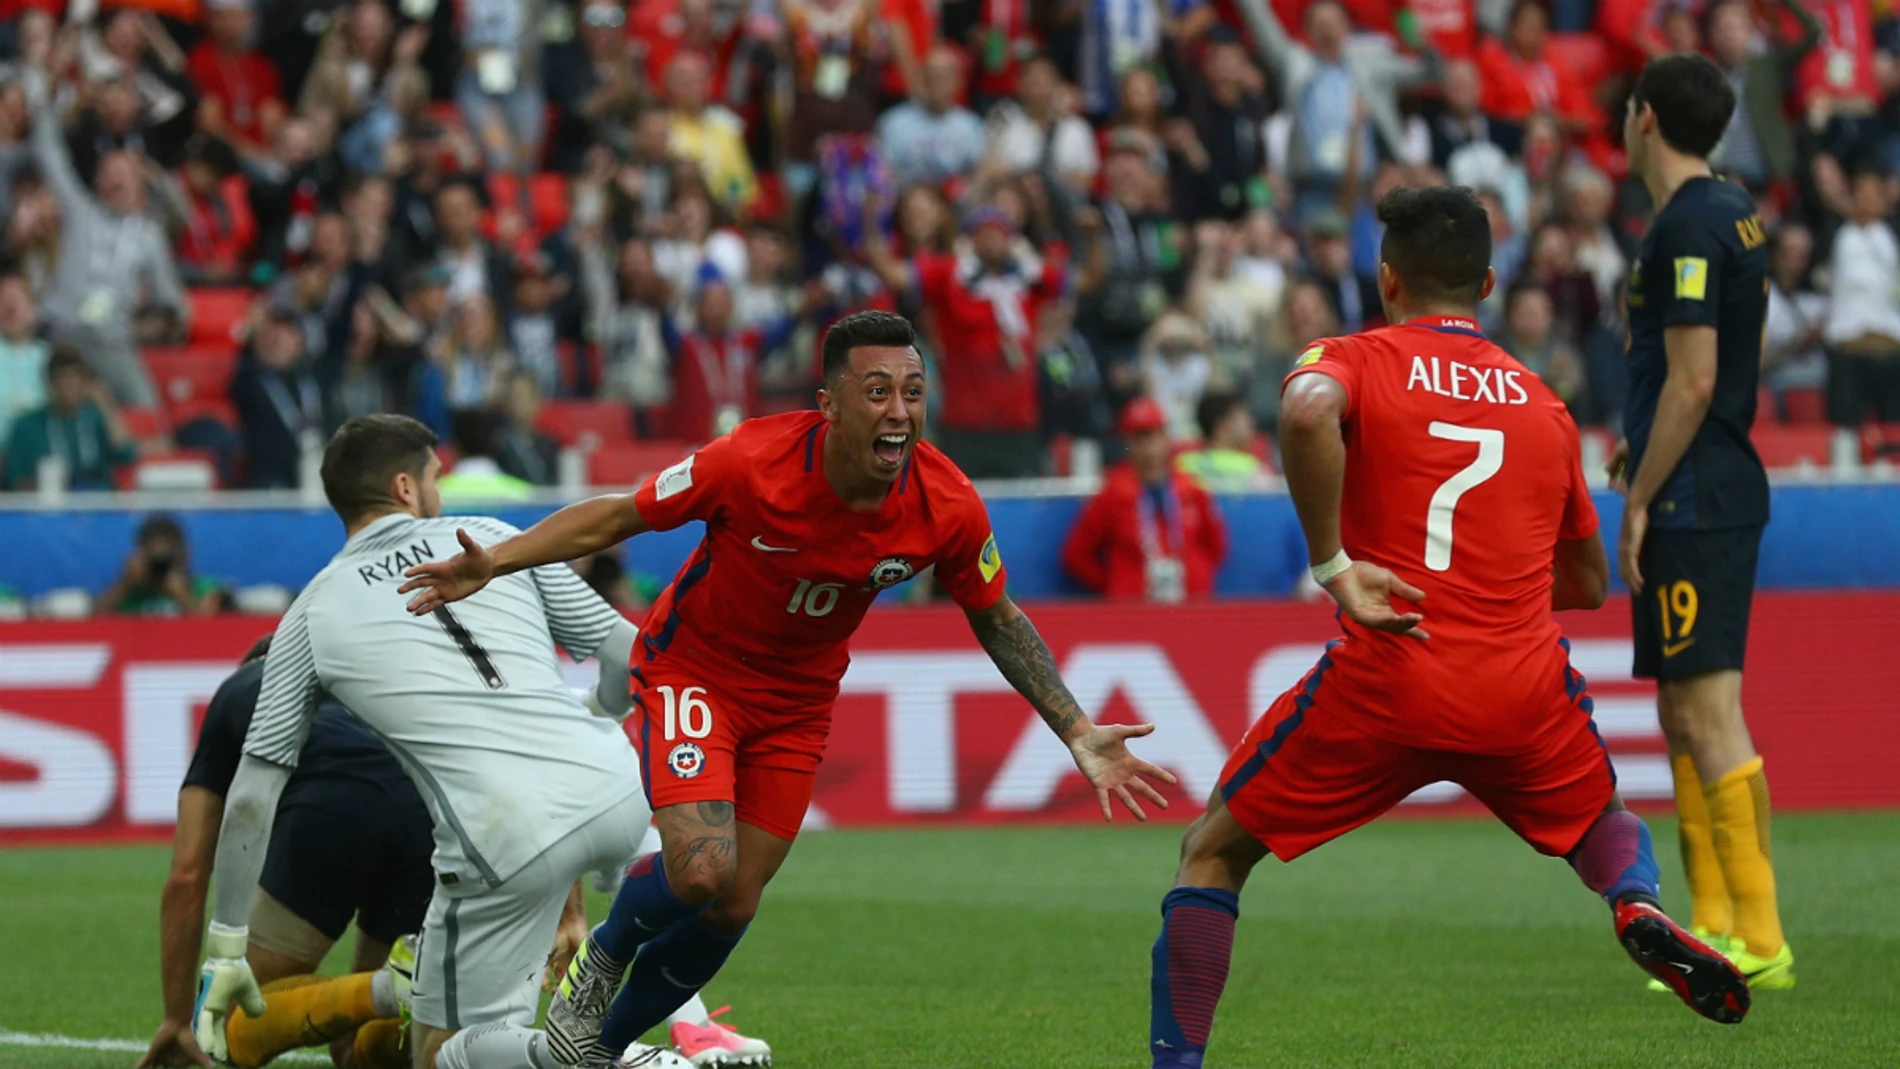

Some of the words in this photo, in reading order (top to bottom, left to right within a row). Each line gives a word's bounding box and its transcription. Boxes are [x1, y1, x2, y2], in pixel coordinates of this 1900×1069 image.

[1441, 319, 1454, 328] LA
[1407, 355, 1529, 405] ALEXIS
[1424, 420, 1505, 572] 7
[357, 538, 434, 586] RYAN
[786, 577, 845, 617] 16
[1657, 579, 1698, 639] 19
[406, 587, 507, 690] 1
[656, 685, 713, 741] 16
